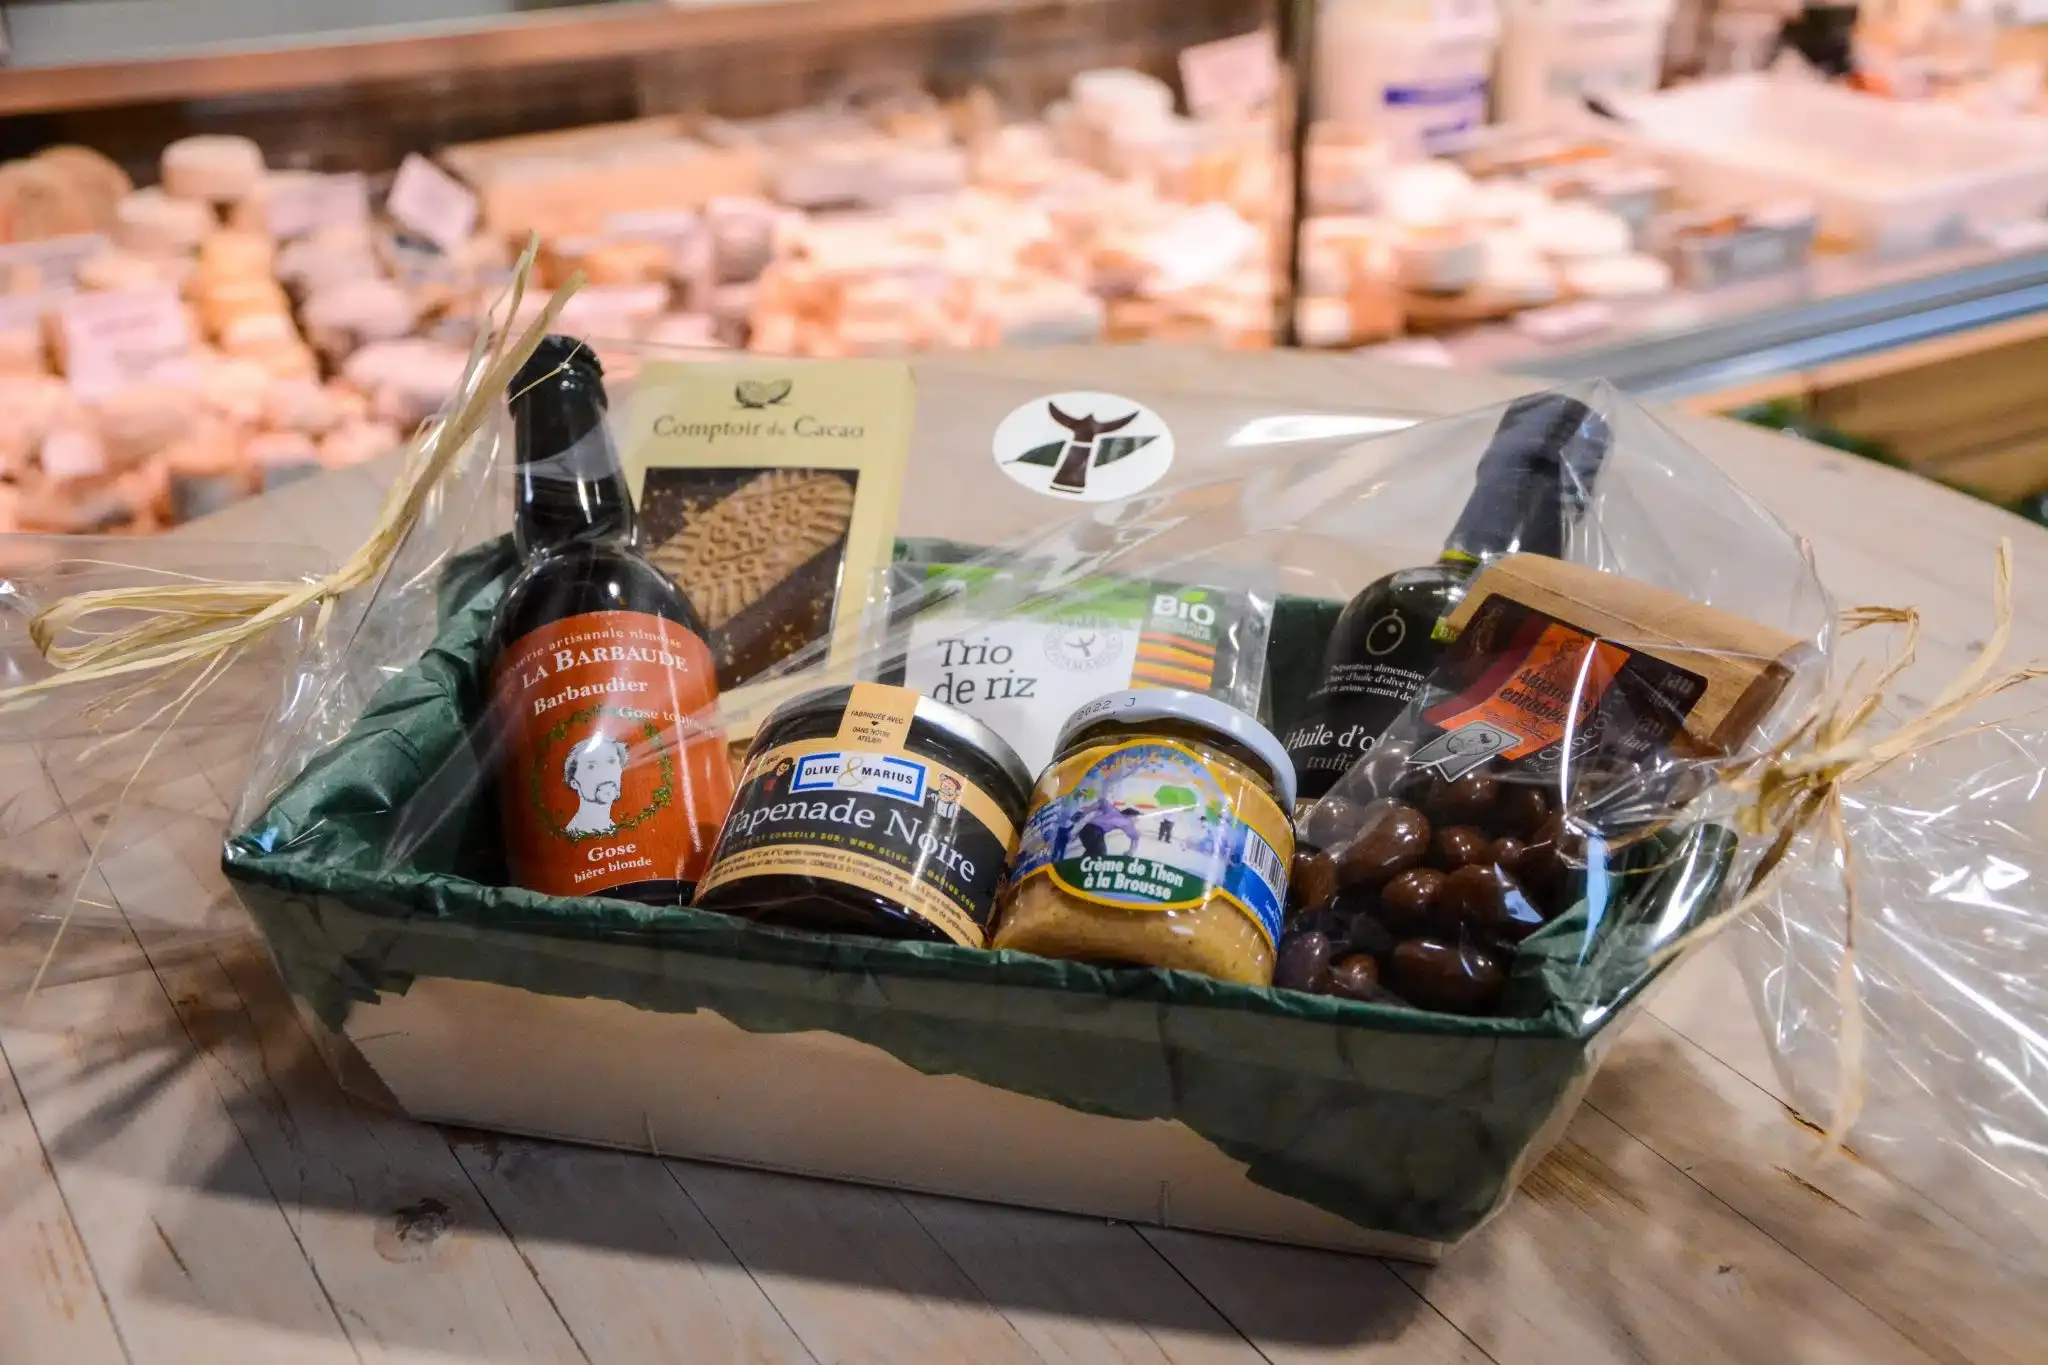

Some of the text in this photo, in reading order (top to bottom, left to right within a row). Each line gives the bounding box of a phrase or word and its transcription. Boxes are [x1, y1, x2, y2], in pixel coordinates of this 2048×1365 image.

[653, 413, 761, 444] Comptoir
[793, 415, 865, 439] Cacao
[1152, 594, 1217, 628] BIO
[549, 627, 625, 652] artisanale
[937, 635, 1013, 668] Trio
[522, 644, 688, 689] LA BARBAUDE
[1373, 662, 1426, 681] alimentaire
[1375, 674, 1407, 689] d'olive
[533, 677, 649, 717] Barbaudier
[932, 668, 1037, 705] de riz
[1366, 685, 1399, 699] naturel
[618, 705, 659, 720] Gose
[1286, 723, 1333, 752] Huile
[804, 763, 841, 777] OLIVE
[861, 766, 915, 786] MARIUS
[587, 842, 637, 862] Gose
[726, 798, 876, 840] Tapenade
[883, 808, 976, 883] Noire
[574, 857, 653, 884] bière blonde
[1080, 856, 1124, 877] Crème
[1127, 857, 1147, 877] de
[1149, 859, 1184, 888] Thon
[1083, 869, 1173, 901] à la Brousse
